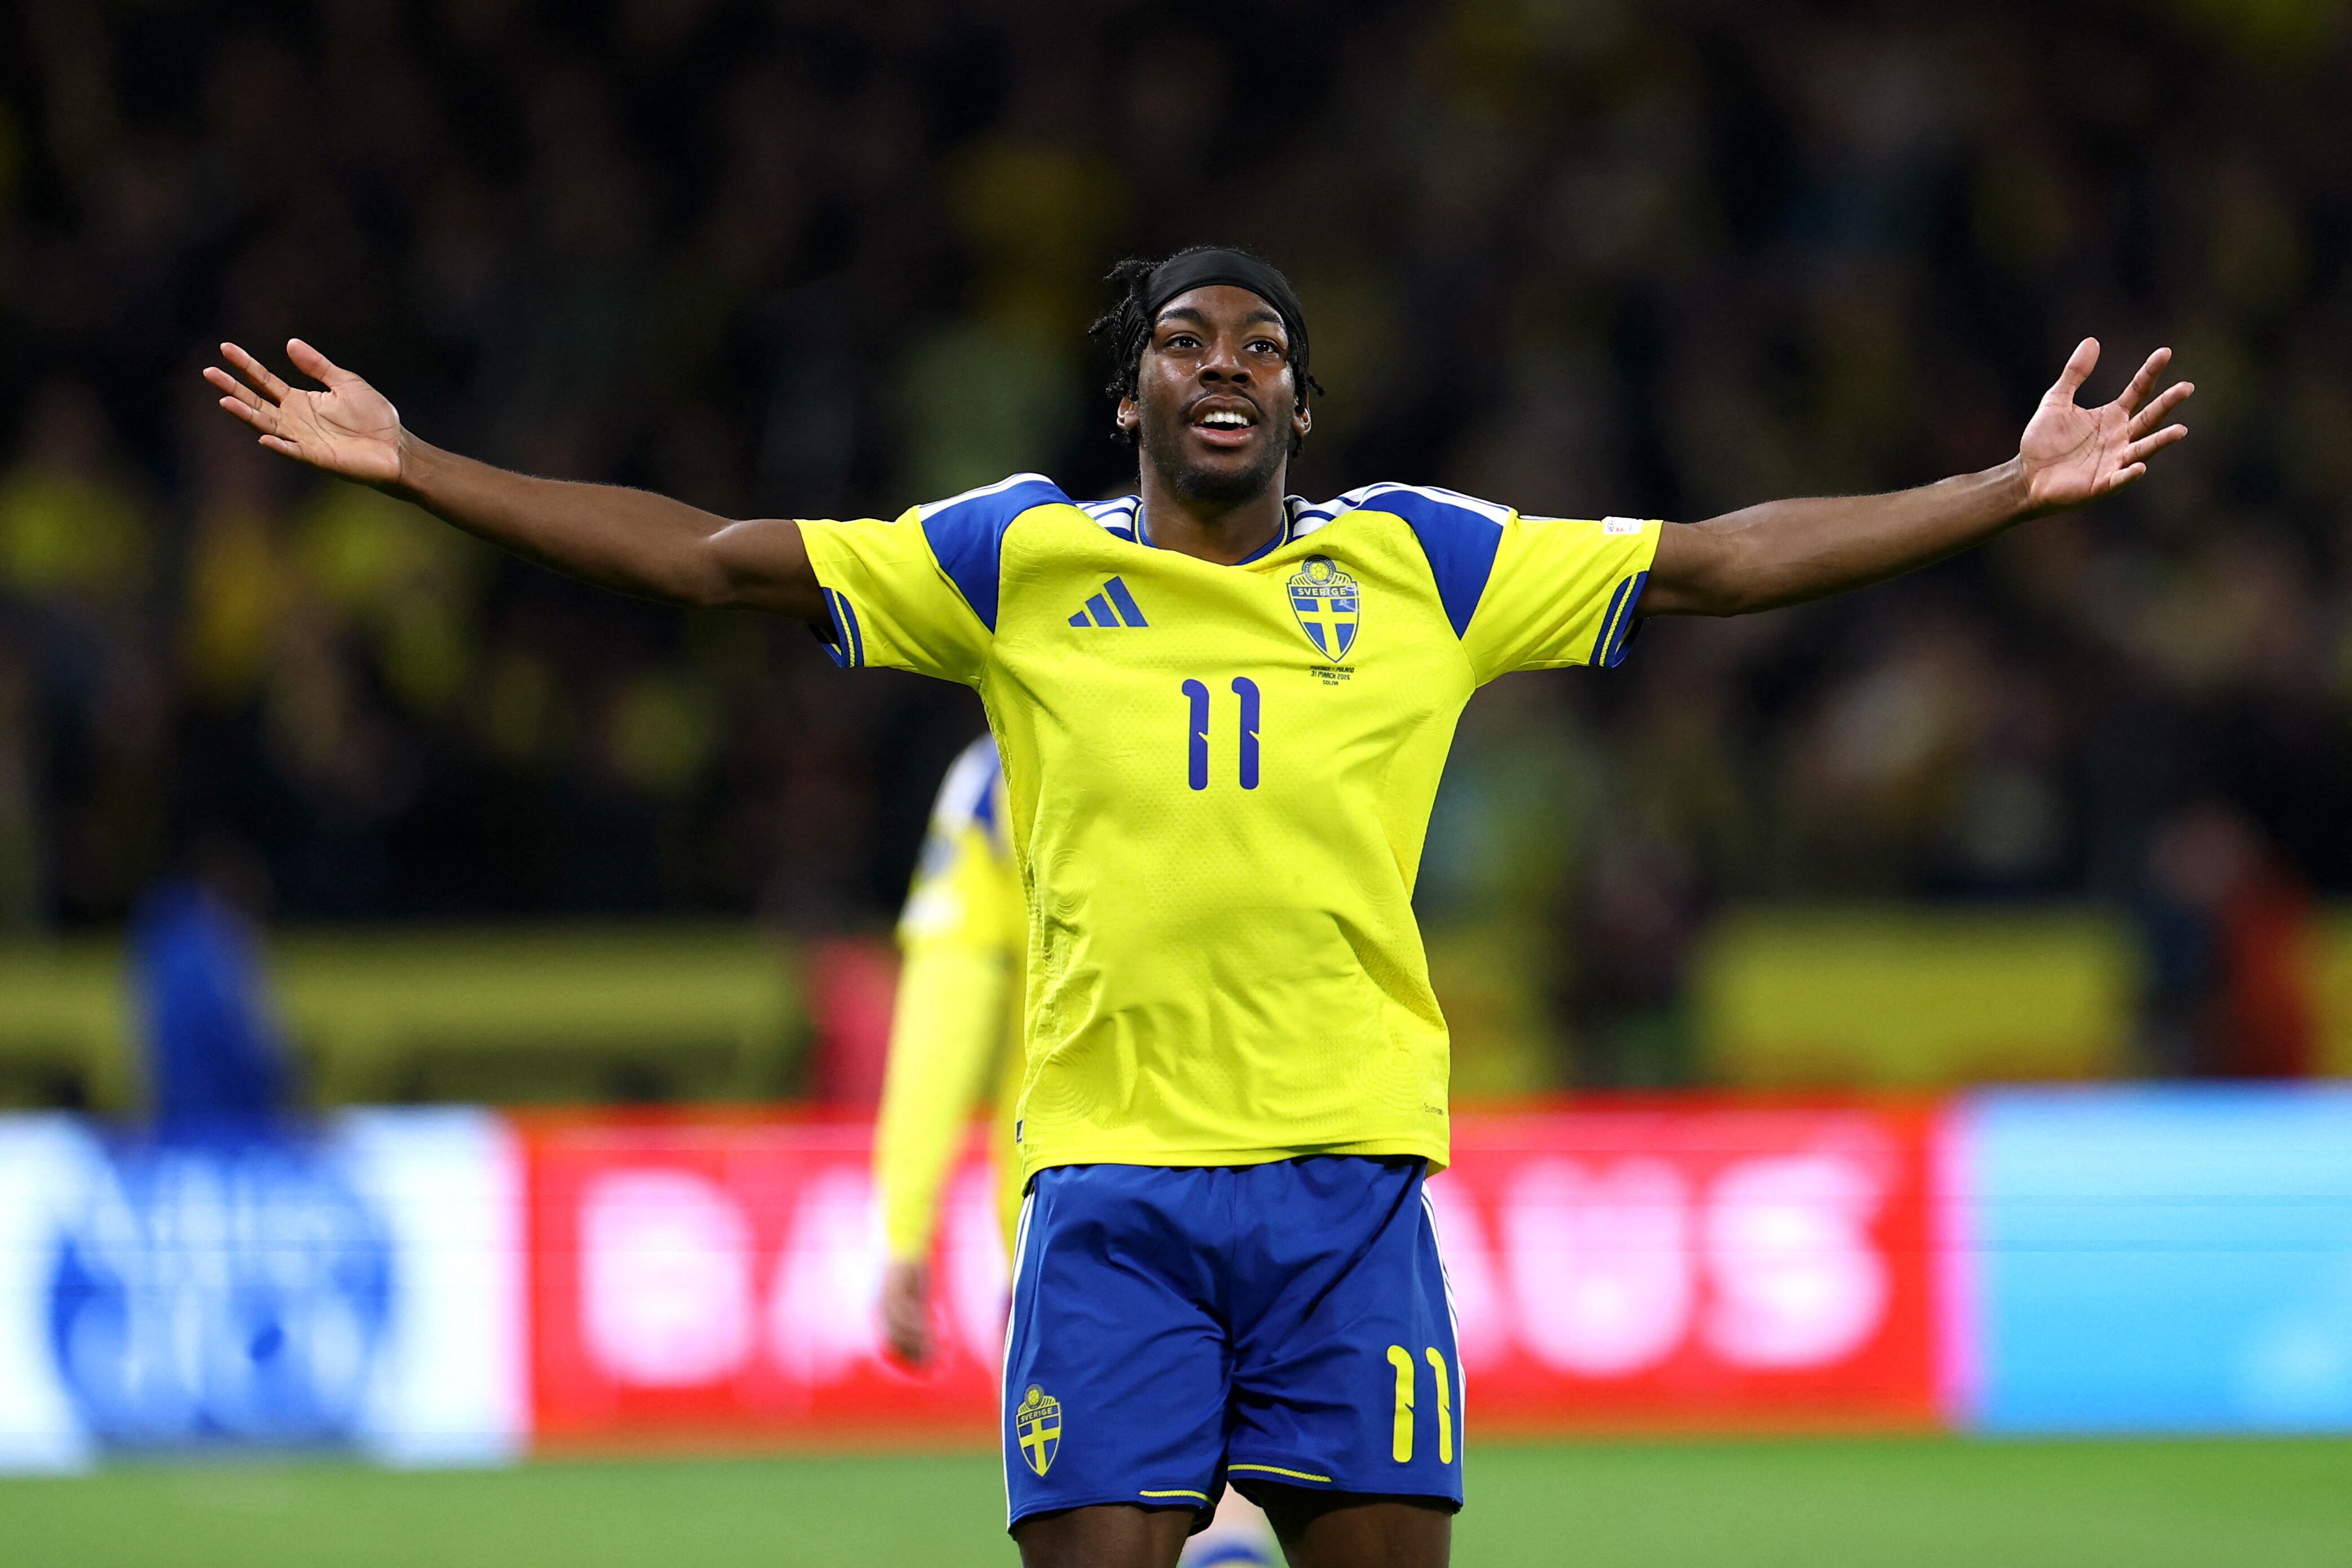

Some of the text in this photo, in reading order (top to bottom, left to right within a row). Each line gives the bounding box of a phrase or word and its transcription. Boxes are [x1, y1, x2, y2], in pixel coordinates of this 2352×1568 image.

[1298, 587, 1347, 596] SVERIGE
[1182, 676, 1260, 790] 11
[1020, 1407, 1053, 1422] SVERIGE
[1387, 1345, 1453, 1464] 11
